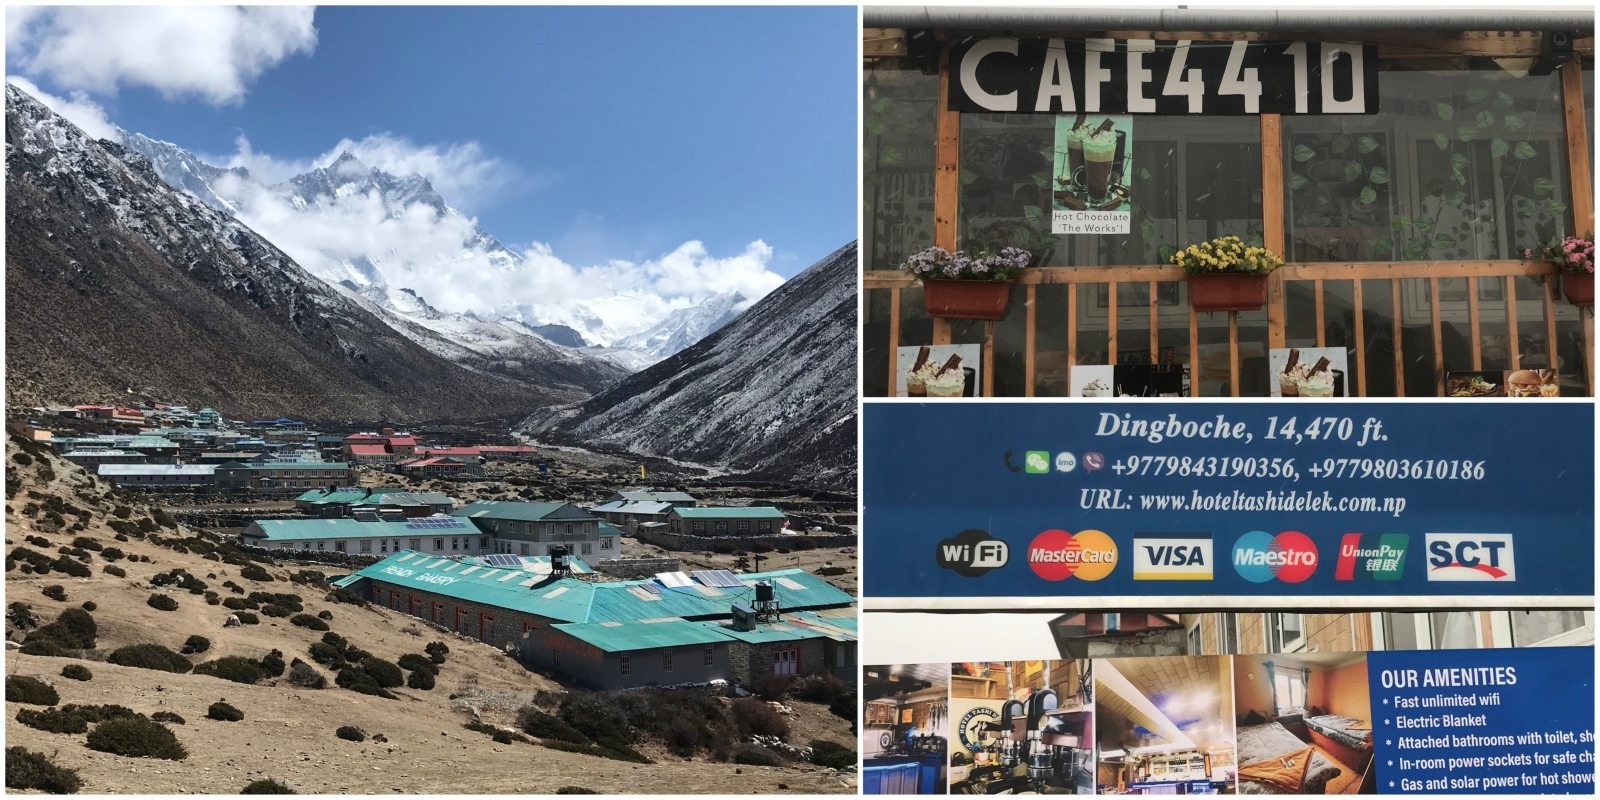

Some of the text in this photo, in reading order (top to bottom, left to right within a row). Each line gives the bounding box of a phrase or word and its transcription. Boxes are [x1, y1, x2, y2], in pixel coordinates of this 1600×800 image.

[1053, 212, 1129, 221] Hot Chocolate
[1095, 412, 1388, 447] Dingboche, 14,470 ft.
[1058, 459, 1074, 467] imo
[1111, 455, 1486, 482] +9779843190356, +9779803610186
[1080, 488, 1407, 518] URL: www.hoteltashidelek.com.np
[1030, 547, 1116, 564] MasterCard
[1142, 545, 1205, 566] VISA
[1234, 548, 1317, 566] Maestro
[1342, 545, 1404, 561] UnionPay
[1429, 540, 1506, 568] SCT
[1365, 558, 1398, 572] 银联
[1381, 667, 1517, 689] OUR AMENITIES
[1394, 692, 1501, 708] Fast unlimited wifi
[1396, 713, 1487, 729] Electric Blanket
[1398, 729, 1595, 750] Attached bathrooms with toilet, sh
[1399, 749, 1595, 771] In-room power sockets for safe ch
[1401, 778, 1423, 791] Gas
[1426, 776, 1448, 790] and
[1450, 775, 1480, 790] solar
[1482, 777, 1519, 791] power
[1521, 773, 1537, 786] for
[1540, 772, 1559, 785] hot
